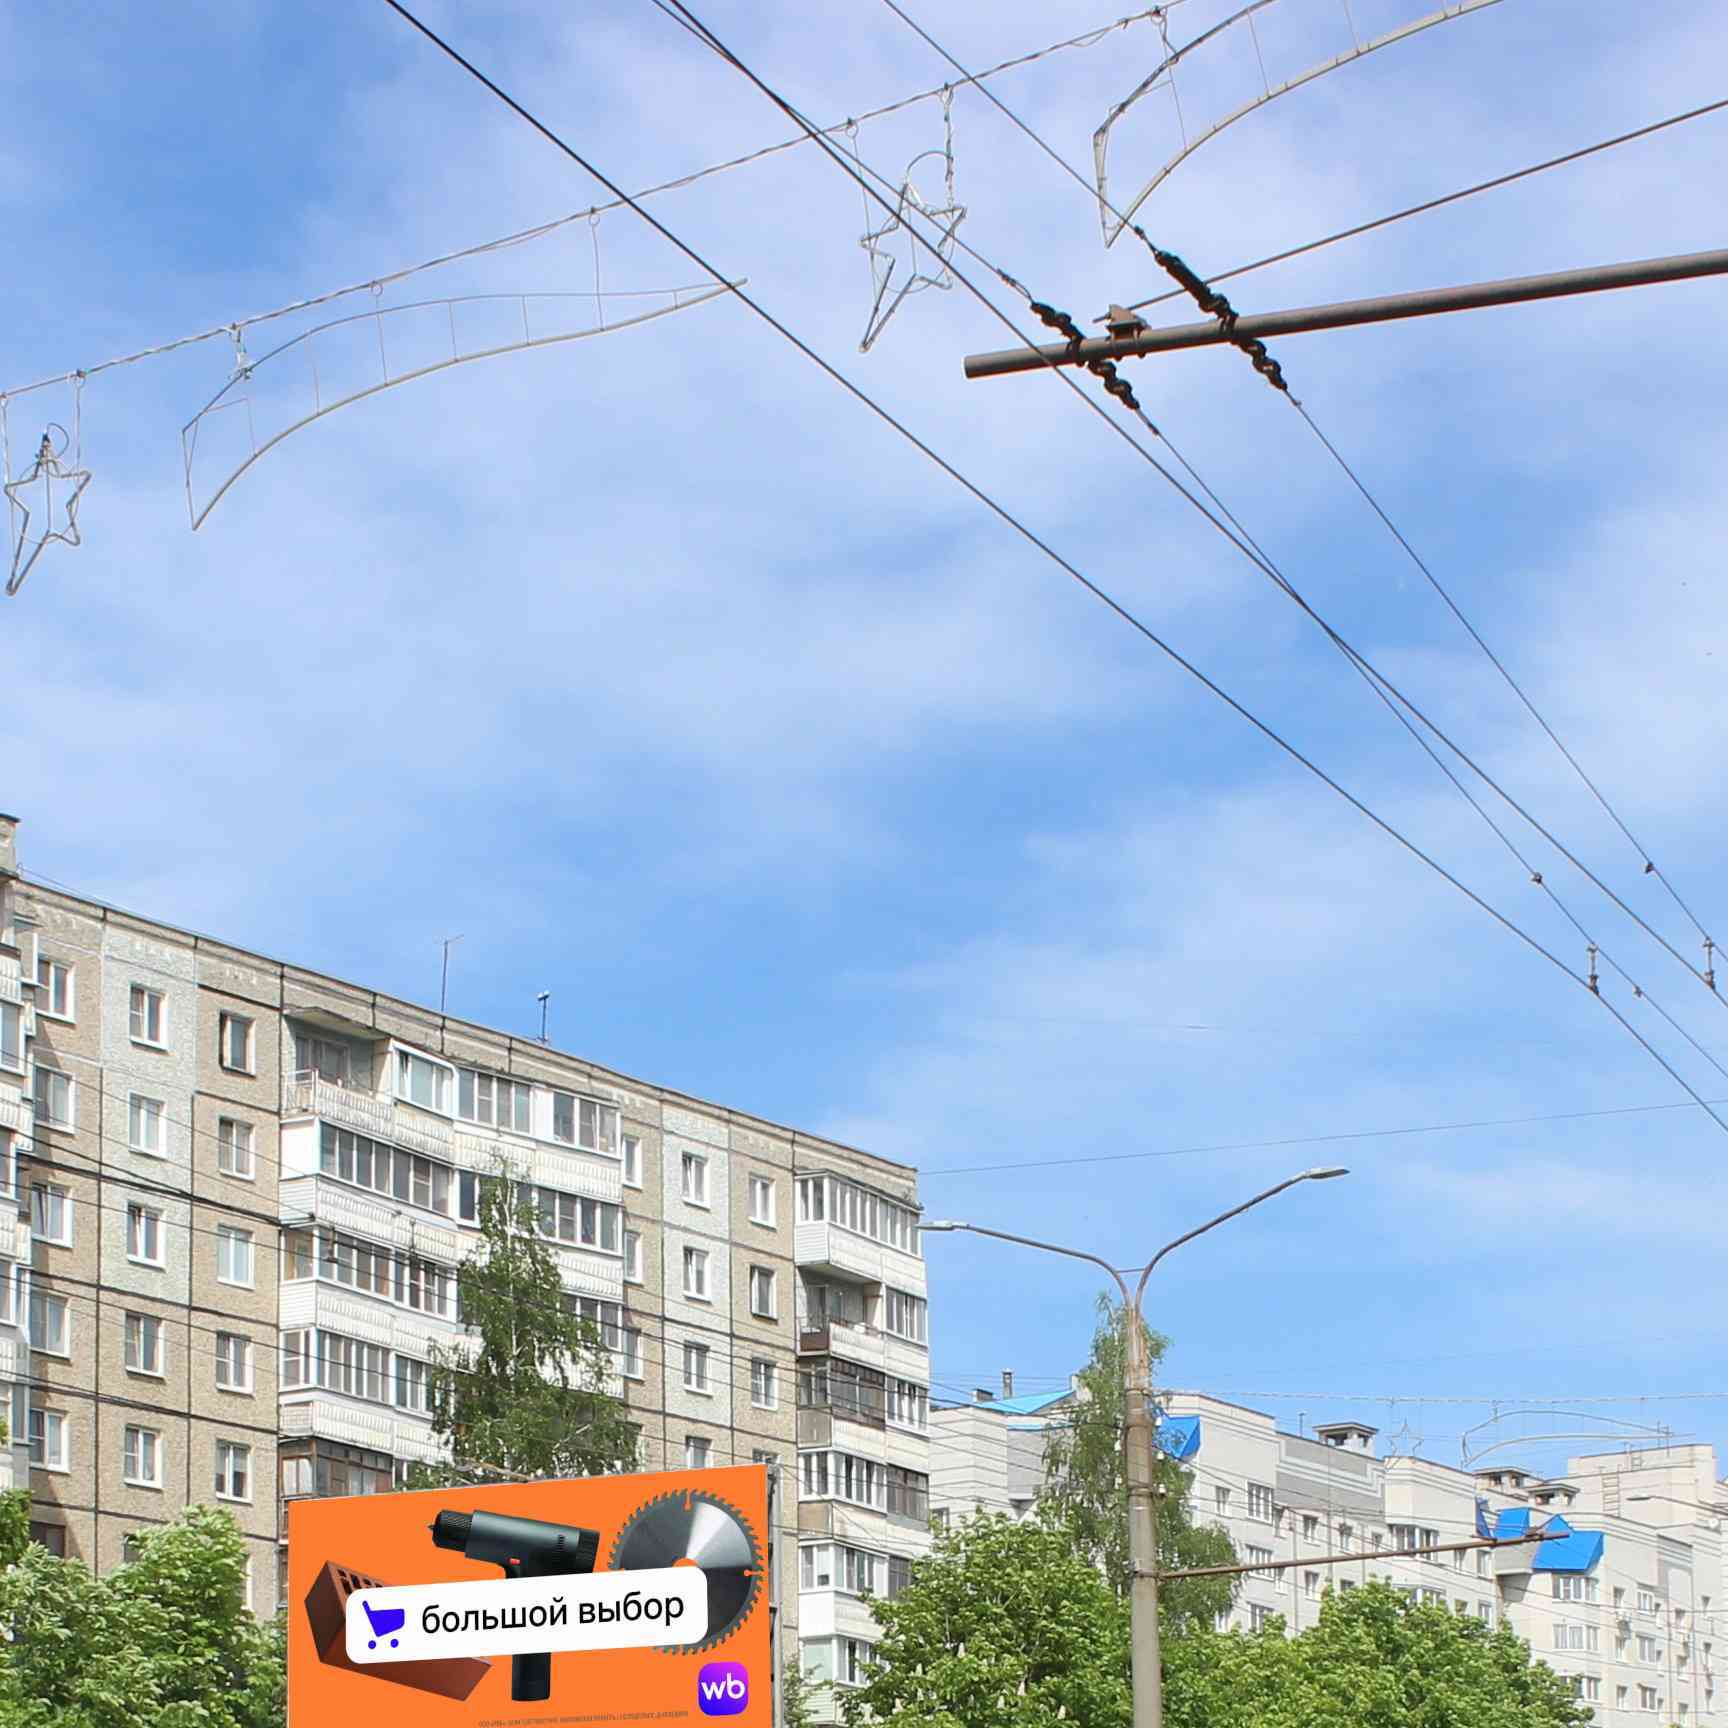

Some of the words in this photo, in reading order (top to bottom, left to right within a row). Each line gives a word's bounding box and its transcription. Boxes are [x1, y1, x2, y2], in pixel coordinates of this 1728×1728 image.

[422, 1596, 568, 1634] большой
[578, 1590, 685, 1627] выбор
[700, 1671, 745, 1700] wb
